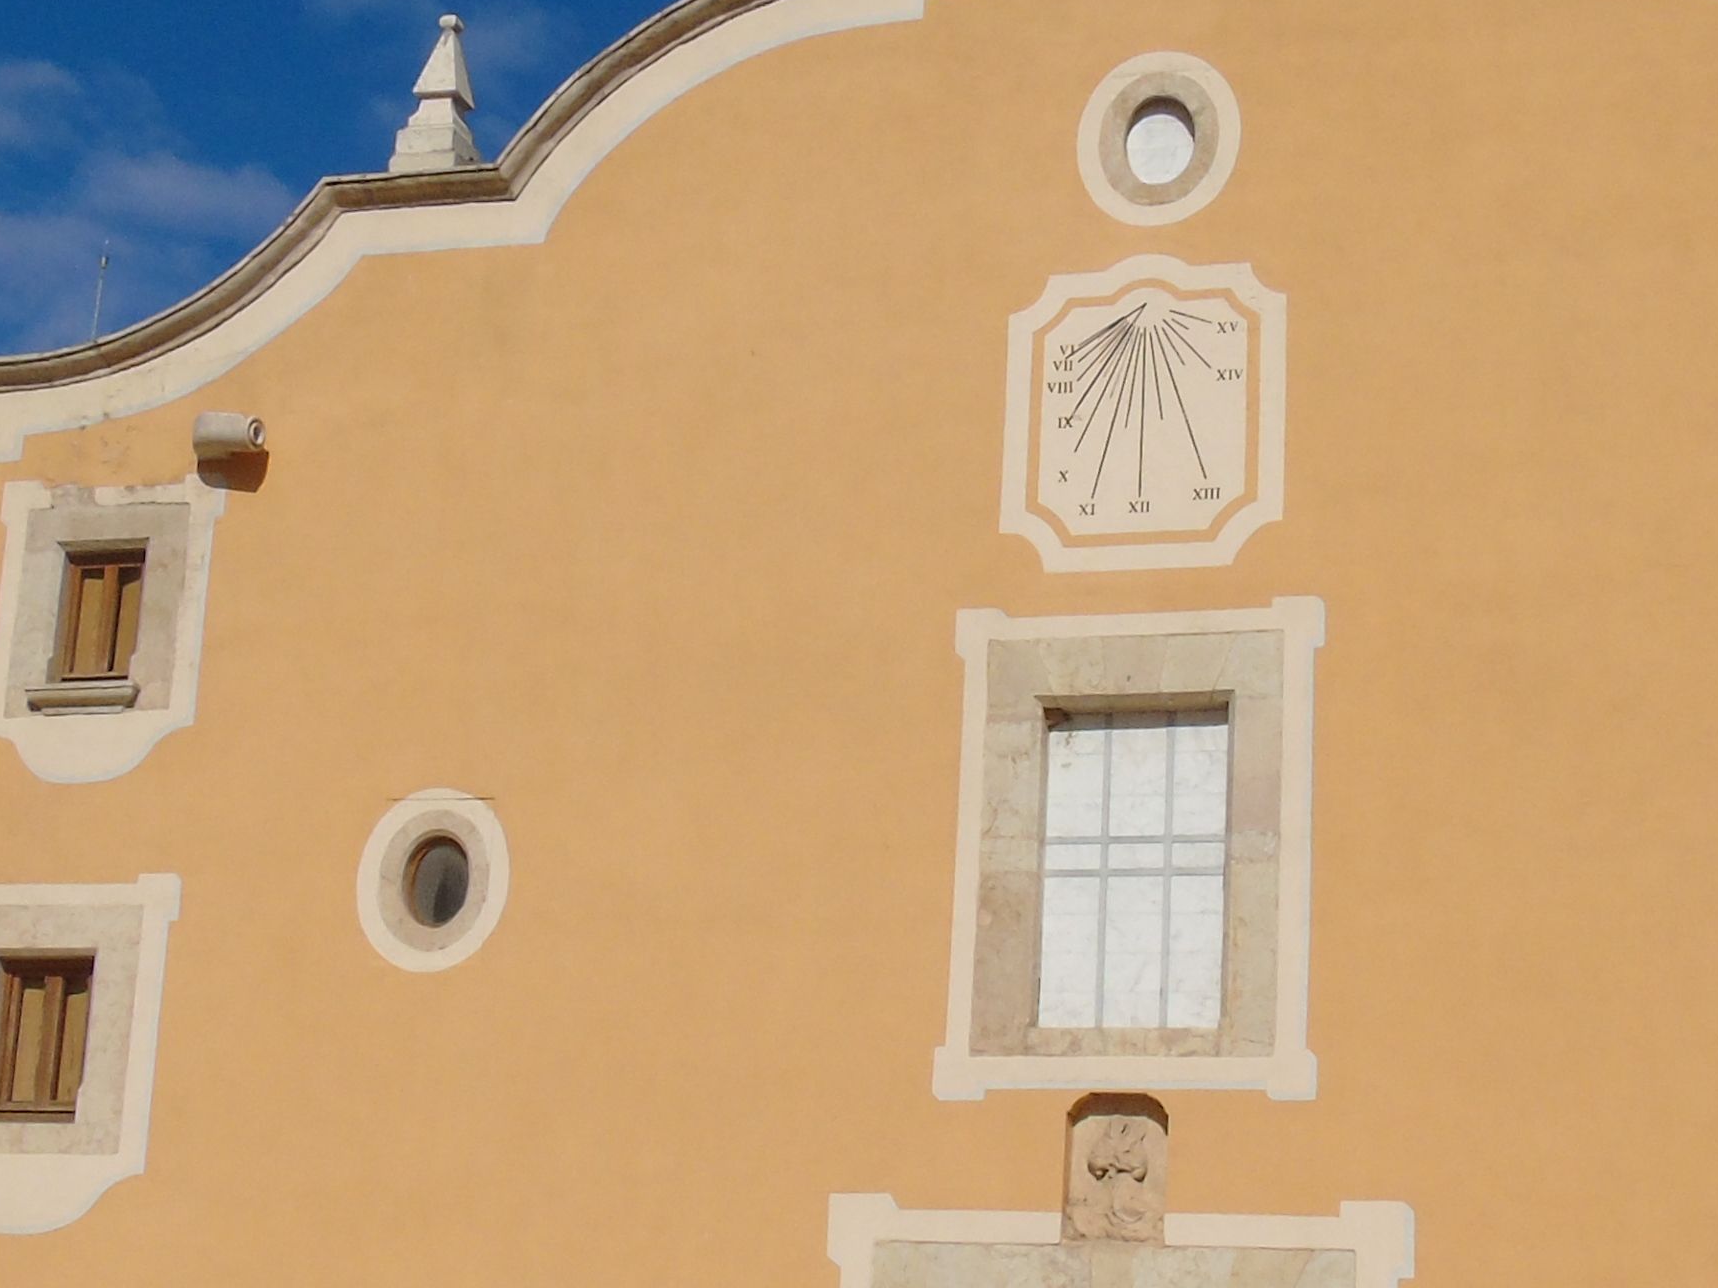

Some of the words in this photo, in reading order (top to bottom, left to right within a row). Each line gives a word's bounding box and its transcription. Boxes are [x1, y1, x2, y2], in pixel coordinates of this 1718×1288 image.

[1216, 321, 1239, 334] XV
[1052, 360, 1074, 372] VII
[1216, 368, 1244, 381] XIV
[1047, 381, 1074, 394] VIII
[1058, 416, 1074, 429] IX
[1058, 470, 1069, 483] X
[1192, 487, 1221, 501] XIII
[1079, 503, 1095, 516] XI
[1128, 500, 1150, 513] XII
